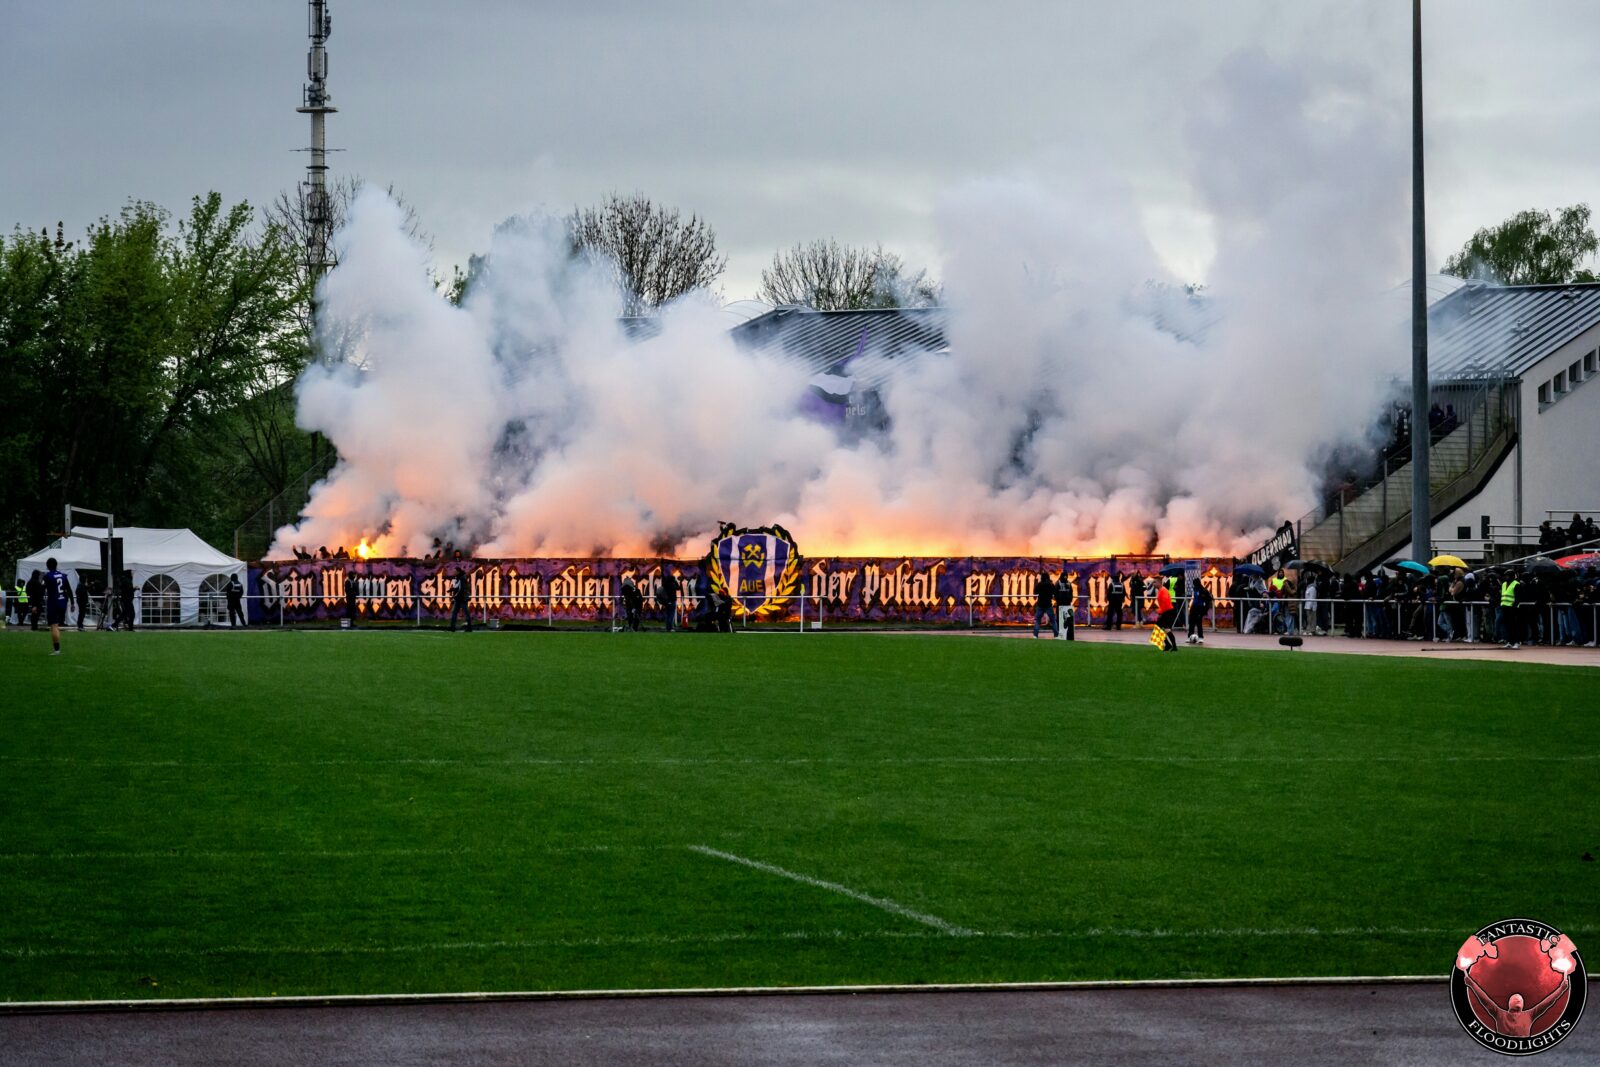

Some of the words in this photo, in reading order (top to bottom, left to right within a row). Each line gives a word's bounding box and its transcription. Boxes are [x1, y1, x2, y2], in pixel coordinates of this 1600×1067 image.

[56, 578, 64, 593] 2
[322, 567, 414, 613] Wppen
[509, 569, 543, 609] im
[551, 566, 613, 609] edlen
[739, 579, 764, 593] AUE
[811, 559, 857, 605] der
